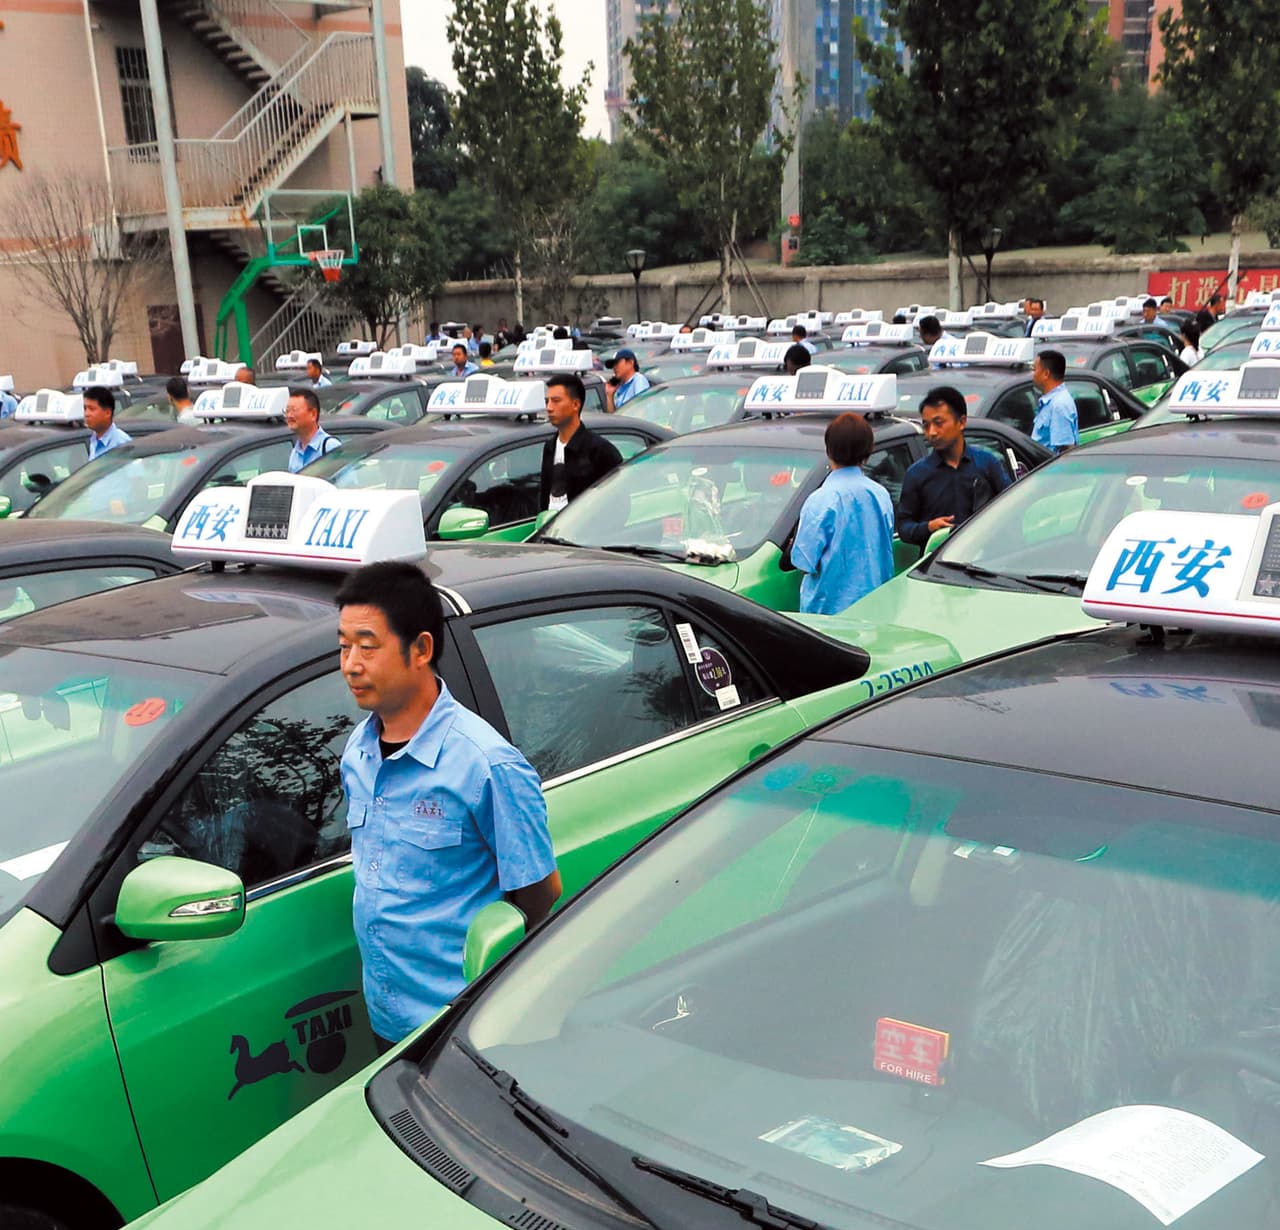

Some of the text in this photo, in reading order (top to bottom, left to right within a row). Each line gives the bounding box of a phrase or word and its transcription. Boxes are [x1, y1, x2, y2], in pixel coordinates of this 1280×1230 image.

[993, 343, 1017, 356] TAXI
[752, 384, 789, 402] 西安
[837, 382, 873, 401] TAXI
[1178, 380, 1229, 402] 西安
[181, 504, 239, 543] 西安
[304, 507, 369, 550] TAXI
[1105, 537, 1233, 598] 西安
[292, 1004, 352, 1045] TAXI
[880, 1028, 934, 1065] 空车
[880, 1062, 932, 1084] FOR HIRE
